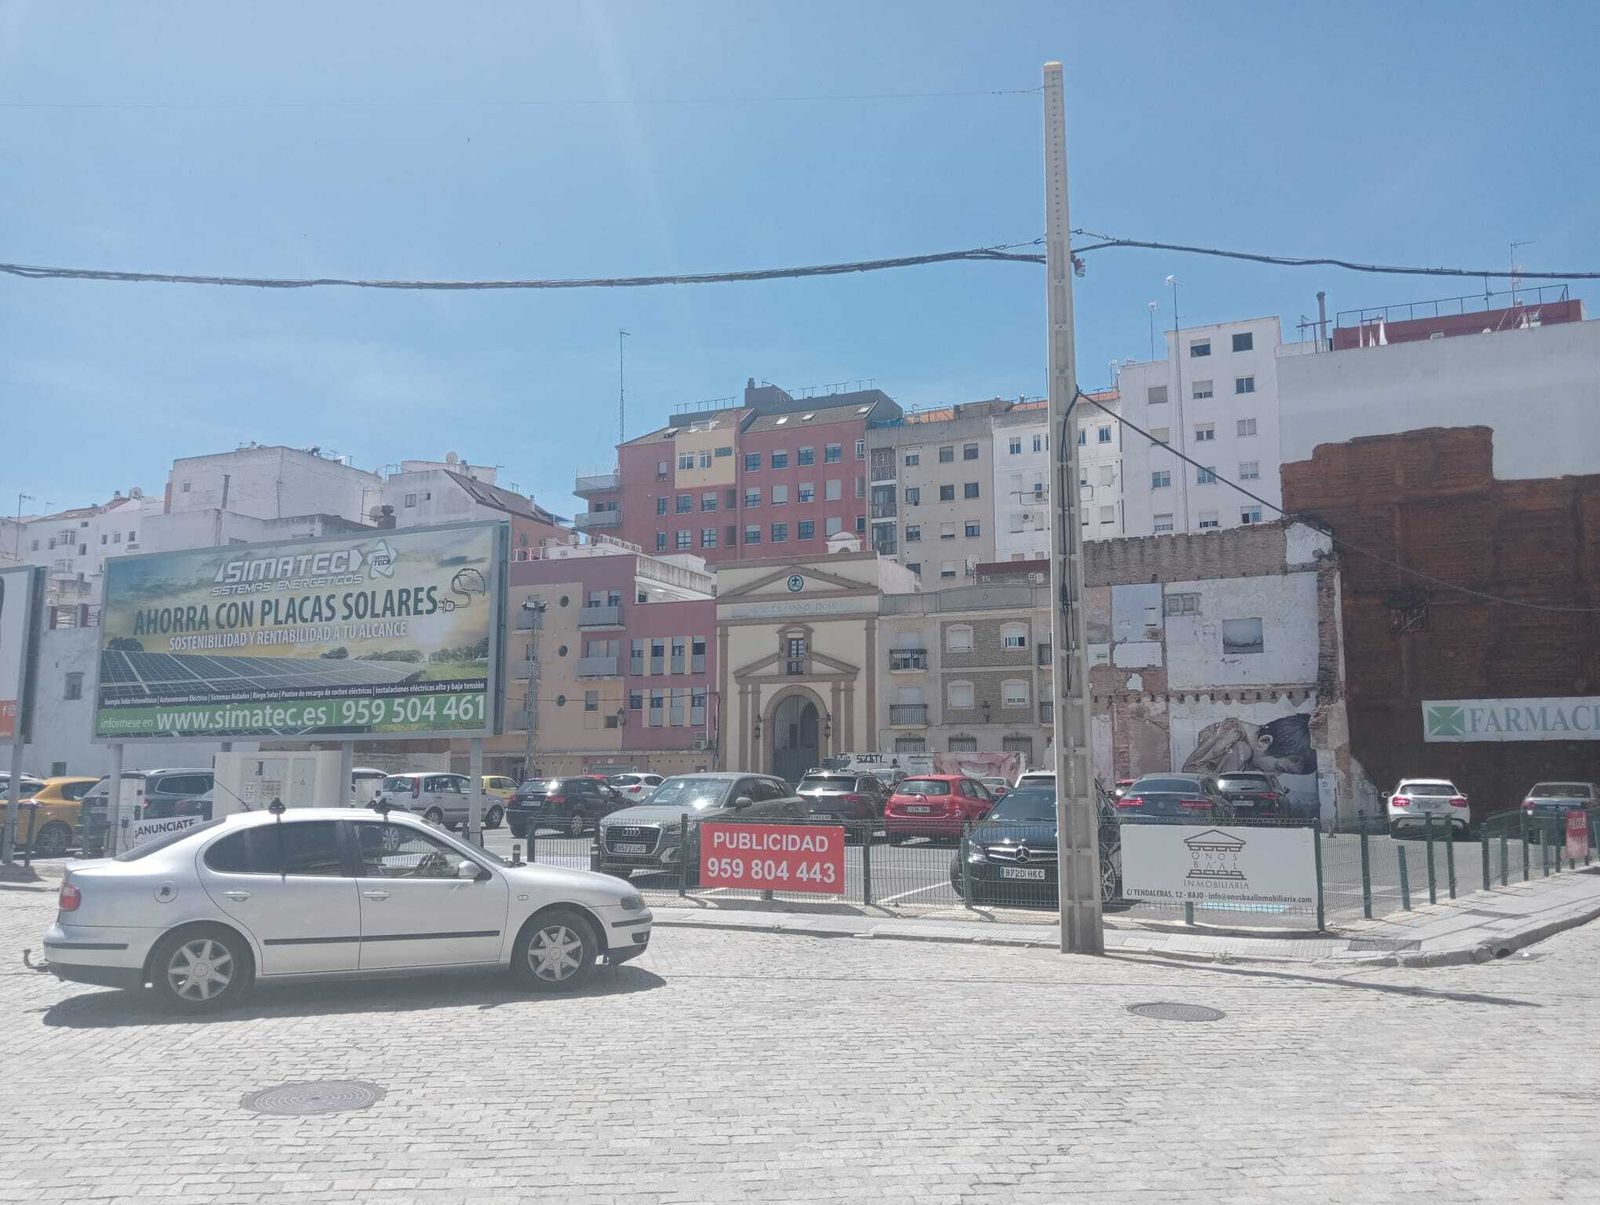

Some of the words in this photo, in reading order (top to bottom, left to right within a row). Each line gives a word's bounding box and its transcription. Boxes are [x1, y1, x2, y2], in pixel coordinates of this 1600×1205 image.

[223, 551, 350, 583] SIMATEC
[211, 583, 272, 597] SISTEMAS
[134, 604, 210, 636] AHORRA
[215, 600, 255, 630] CON
[260, 594, 336, 626] PLACAS
[341, 586, 438, 621] SOLARES
[169, 633, 247, 652] SOSTENIBILIDAD
[248, 634, 256, 647] Y
[257, 627, 332, 647] RENTABILIDAD
[333, 626, 342, 639] A
[343, 625, 357, 639] TU
[358, 621, 408, 638] ALCANCE
[451, 682, 463, 691] baja
[157, 704, 327, 731] www.simatec.es
[342, 699, 386, 724] 959
[392, 697, 437, 723] 504
[442, 694, 485, 721] 461
[143, 718, 154, 729] en
[713, 831, 829, 853] PUBLICIDAD
[707, 857, 744, 879] 959
[750, 859, 790, 881] 804
[796, 861, 836, 884] 443
[1175, 891, 1183, 899] 12
[1187, 891, 1204, 899] BAJO
[1183, 879, 1250, 890] INMOBILIARIA
